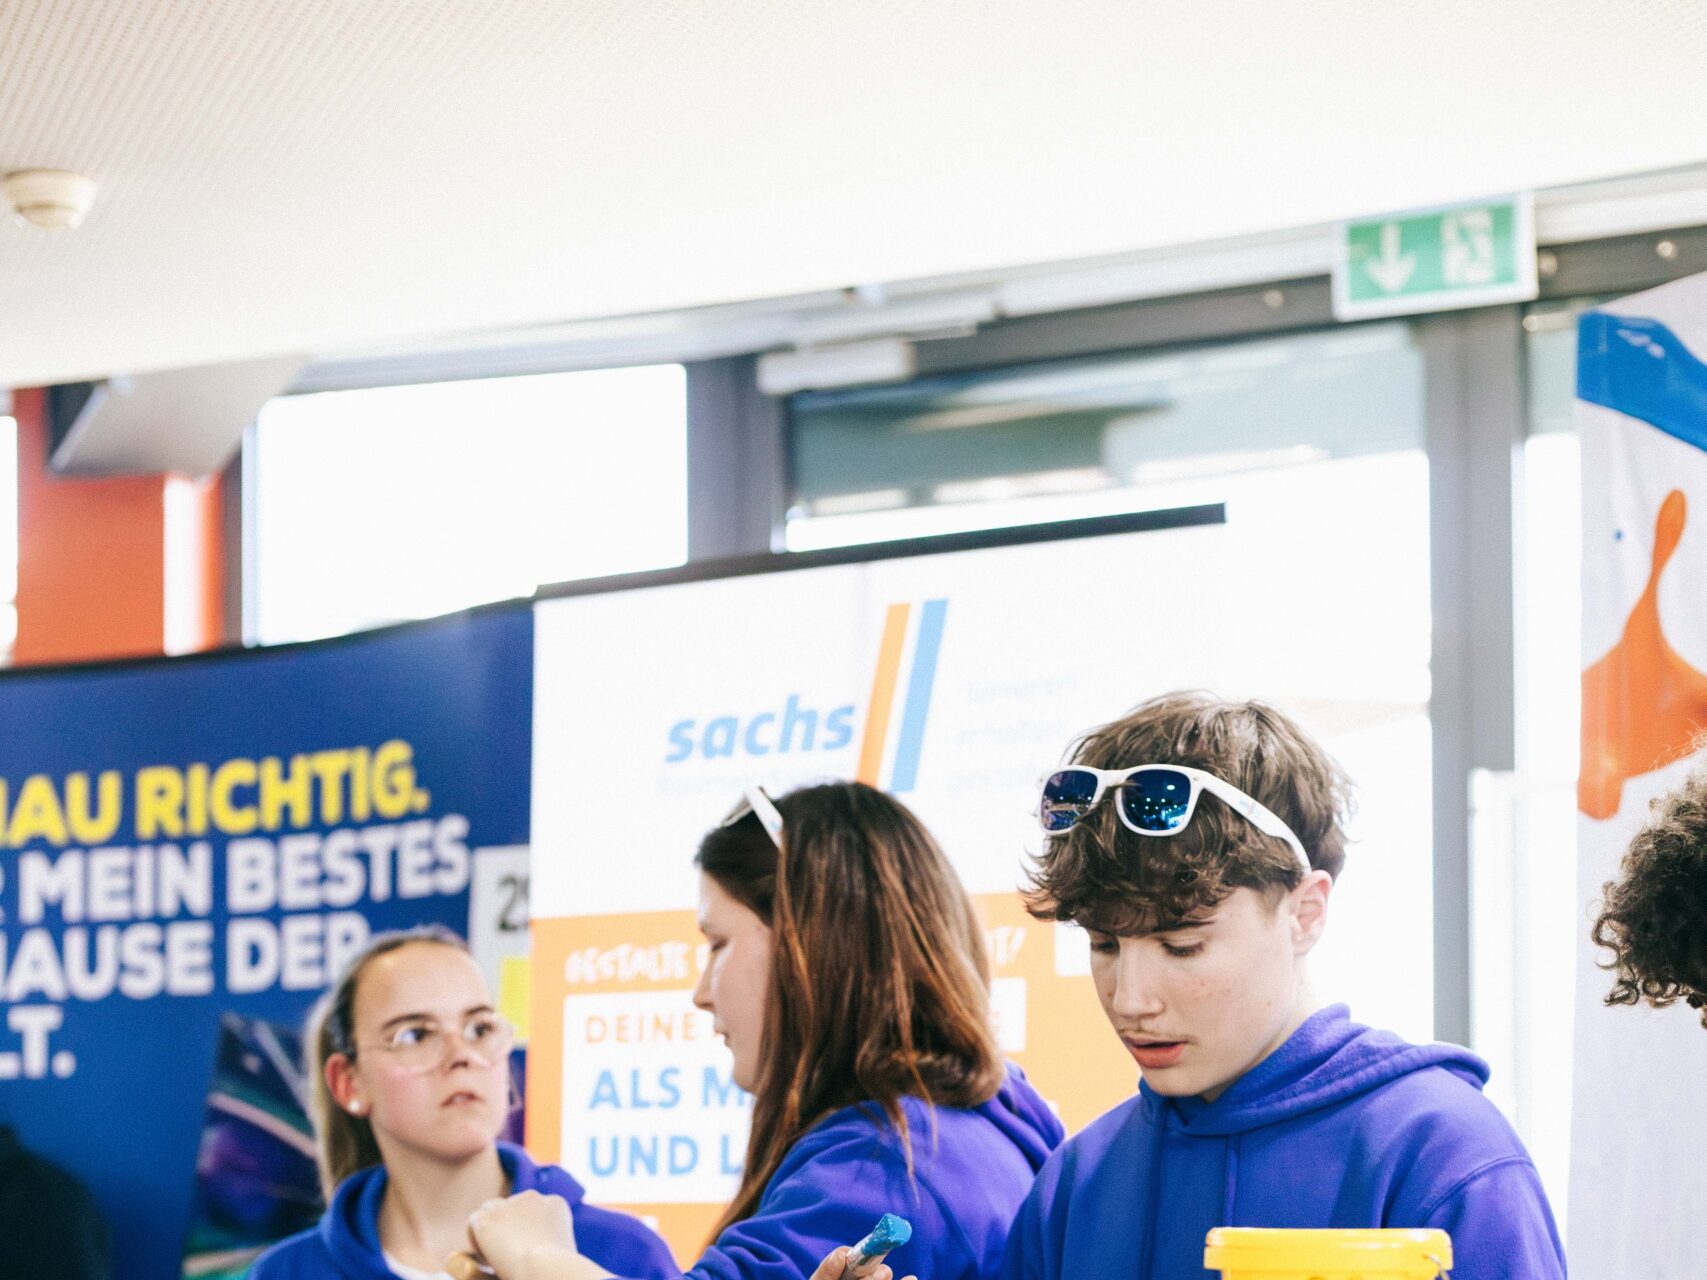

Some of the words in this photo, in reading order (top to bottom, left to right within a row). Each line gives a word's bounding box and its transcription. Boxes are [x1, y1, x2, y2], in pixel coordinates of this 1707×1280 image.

[665, 694, 856, 763] sachs
[135, 738, 431, 840] RICHTIG.
[18, 842, 213, 923] MEIN
[226, 814, 470, 914] BESTES
[0, 919, 214, 1001] AUSE
[586, 1012, 697, 1043] DEINE
[588, 1066, 682, 1110] ALS
[588, 1135, 699, 1178] UND
